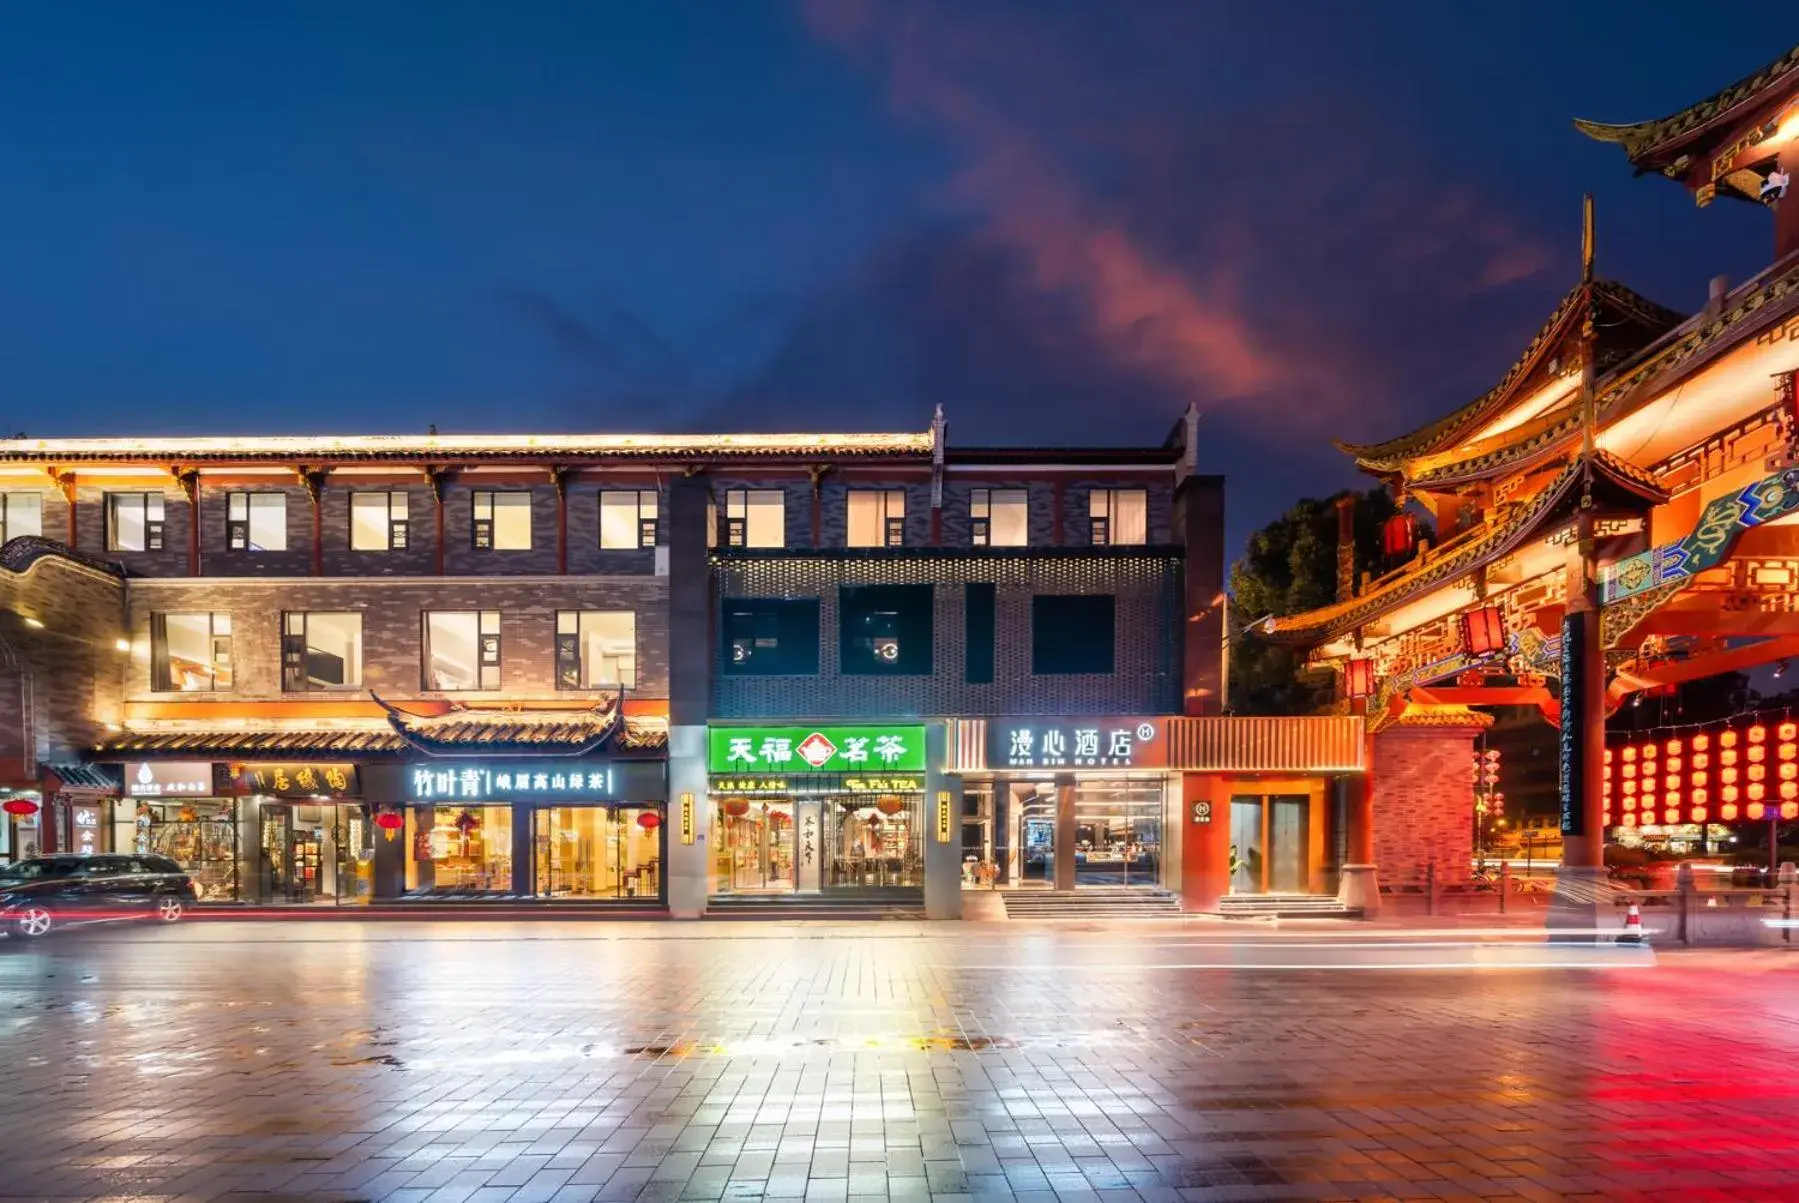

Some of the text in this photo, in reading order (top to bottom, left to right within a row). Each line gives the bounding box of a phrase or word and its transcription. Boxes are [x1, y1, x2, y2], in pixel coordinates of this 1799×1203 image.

[726, 736, 908, 763] 天福 茗茶
[1010, 729, 1132, 756] 漫心酒店
[1009, 758, 1034, 766] MAN
[1074, 758, 1131, 766] HOTEL
[413, 769, 604, 797] 竹叶青 峨眉高山绿茶
[891, 779, 917, 790] TEA
